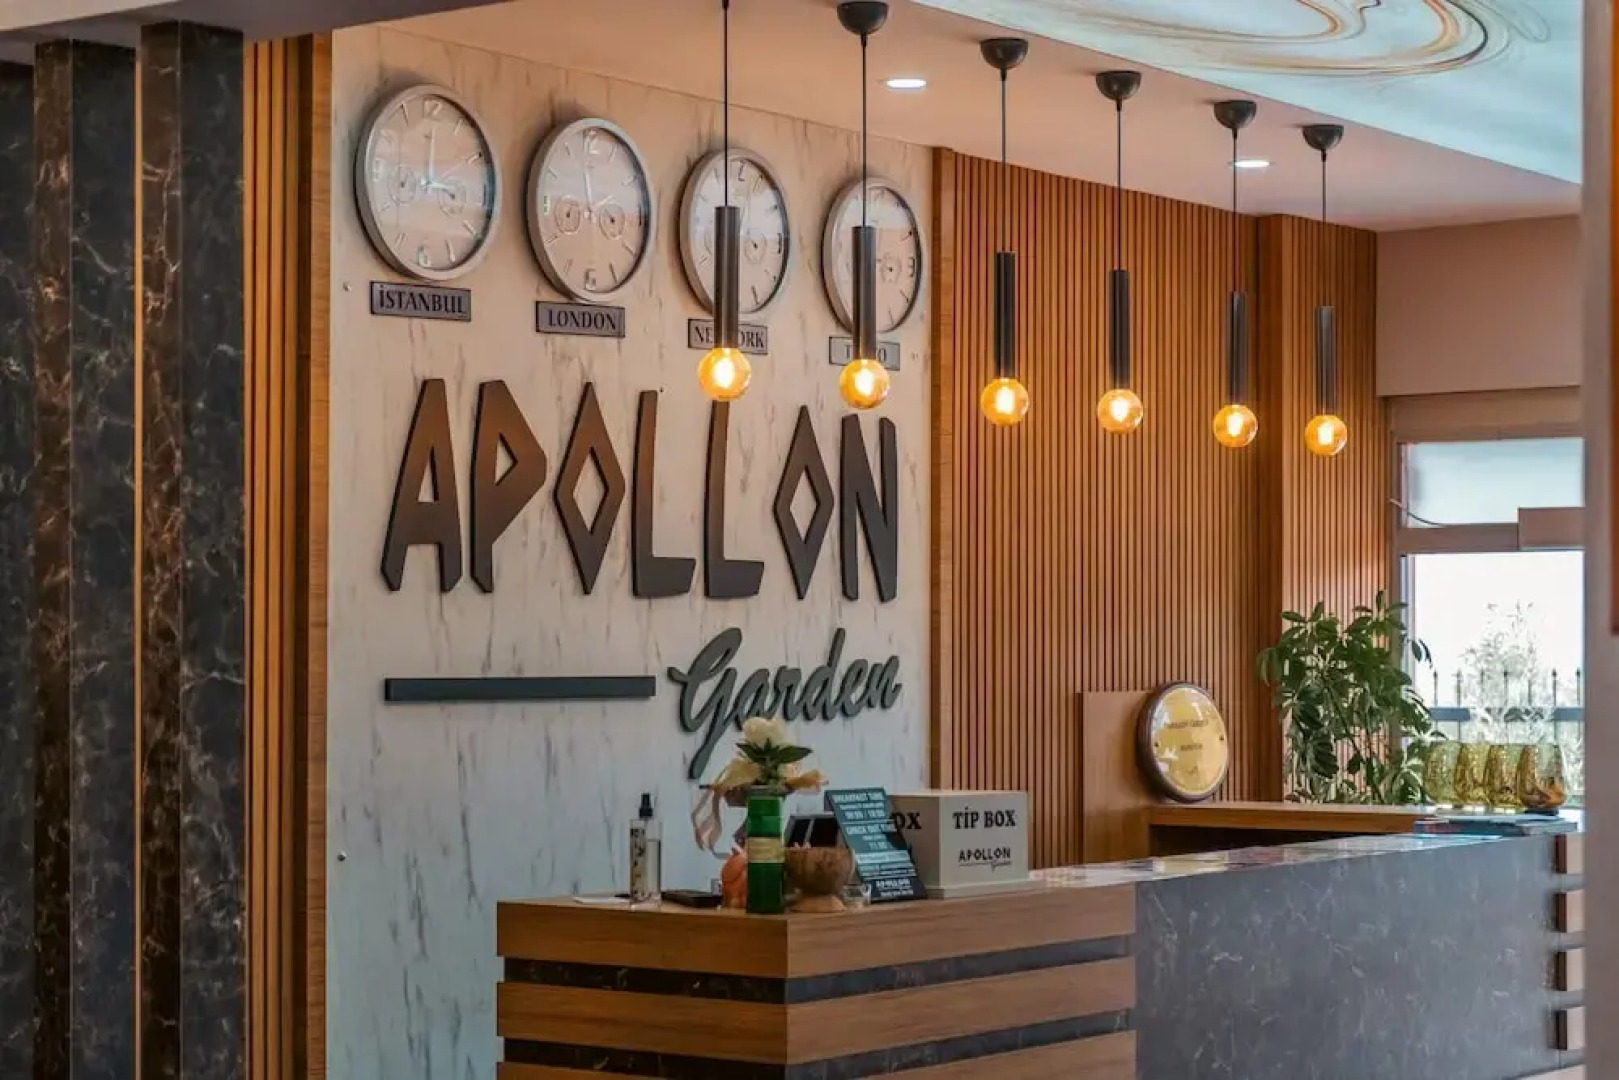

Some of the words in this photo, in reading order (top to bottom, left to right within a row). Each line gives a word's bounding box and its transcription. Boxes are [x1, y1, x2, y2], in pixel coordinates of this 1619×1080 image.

[378, 284, 466, 314] İSTANBUL
[548, 308, 616, 331] LONDON
[694, 325, 715, 344] NE
[738, 330, 765, 349] ORK
[380, 378, 898, 603] APOLLON
[667, 626, 904, 780] Garden
[891, 811, 922, 830] OX
[953, 806, 979, 830] TİP
[983, 809, 1017, 829] BOX
[958, 847, 1011, 862] APOLLON
